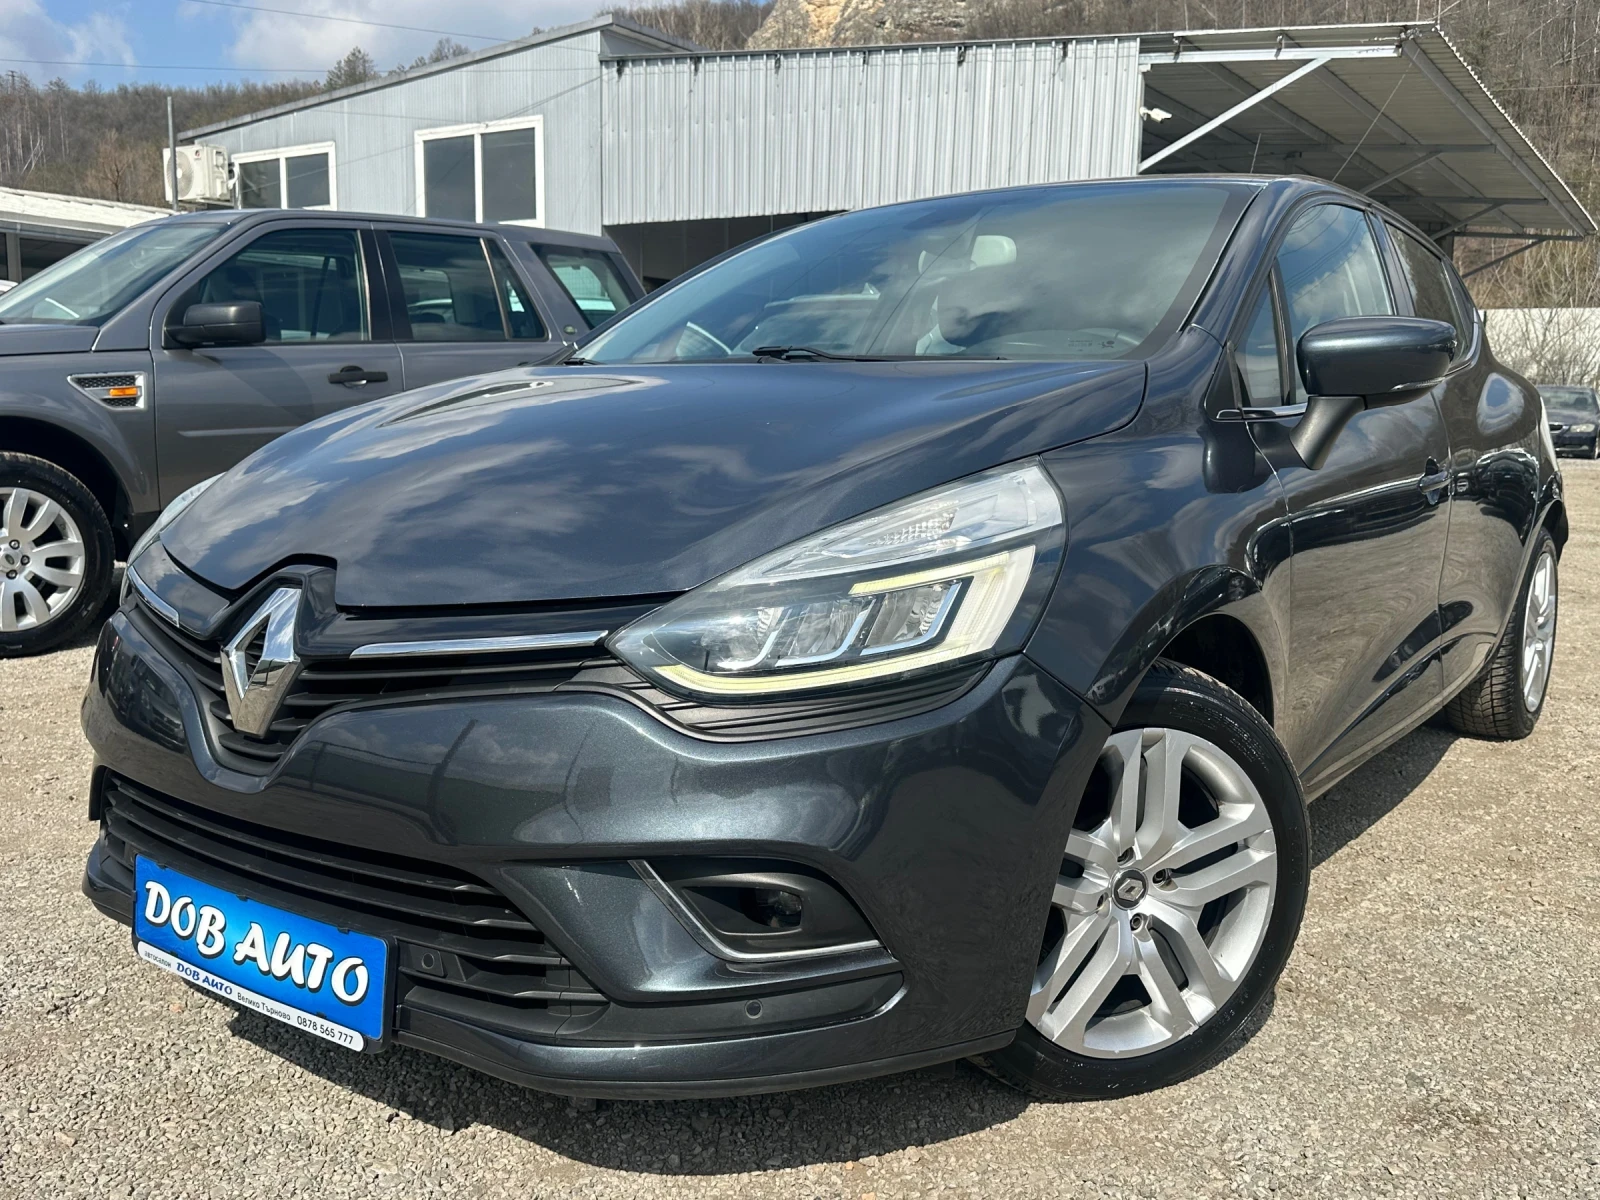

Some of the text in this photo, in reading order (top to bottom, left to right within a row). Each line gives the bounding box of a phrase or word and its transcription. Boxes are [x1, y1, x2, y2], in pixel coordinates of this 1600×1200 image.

[144, 880, 369, 1003] DOB AUTO
[144, 951, 172, 968] автосалон
[176, 962, 200, 981] DOB
[237, 992, 260, 1009] Велико
[261, 1002, 291, 1020] Търново
[297, 1015, 318, 1031] 0878
[319, 1025, 335, 1038] 565
[338, 1031, 354, 1045] 777
